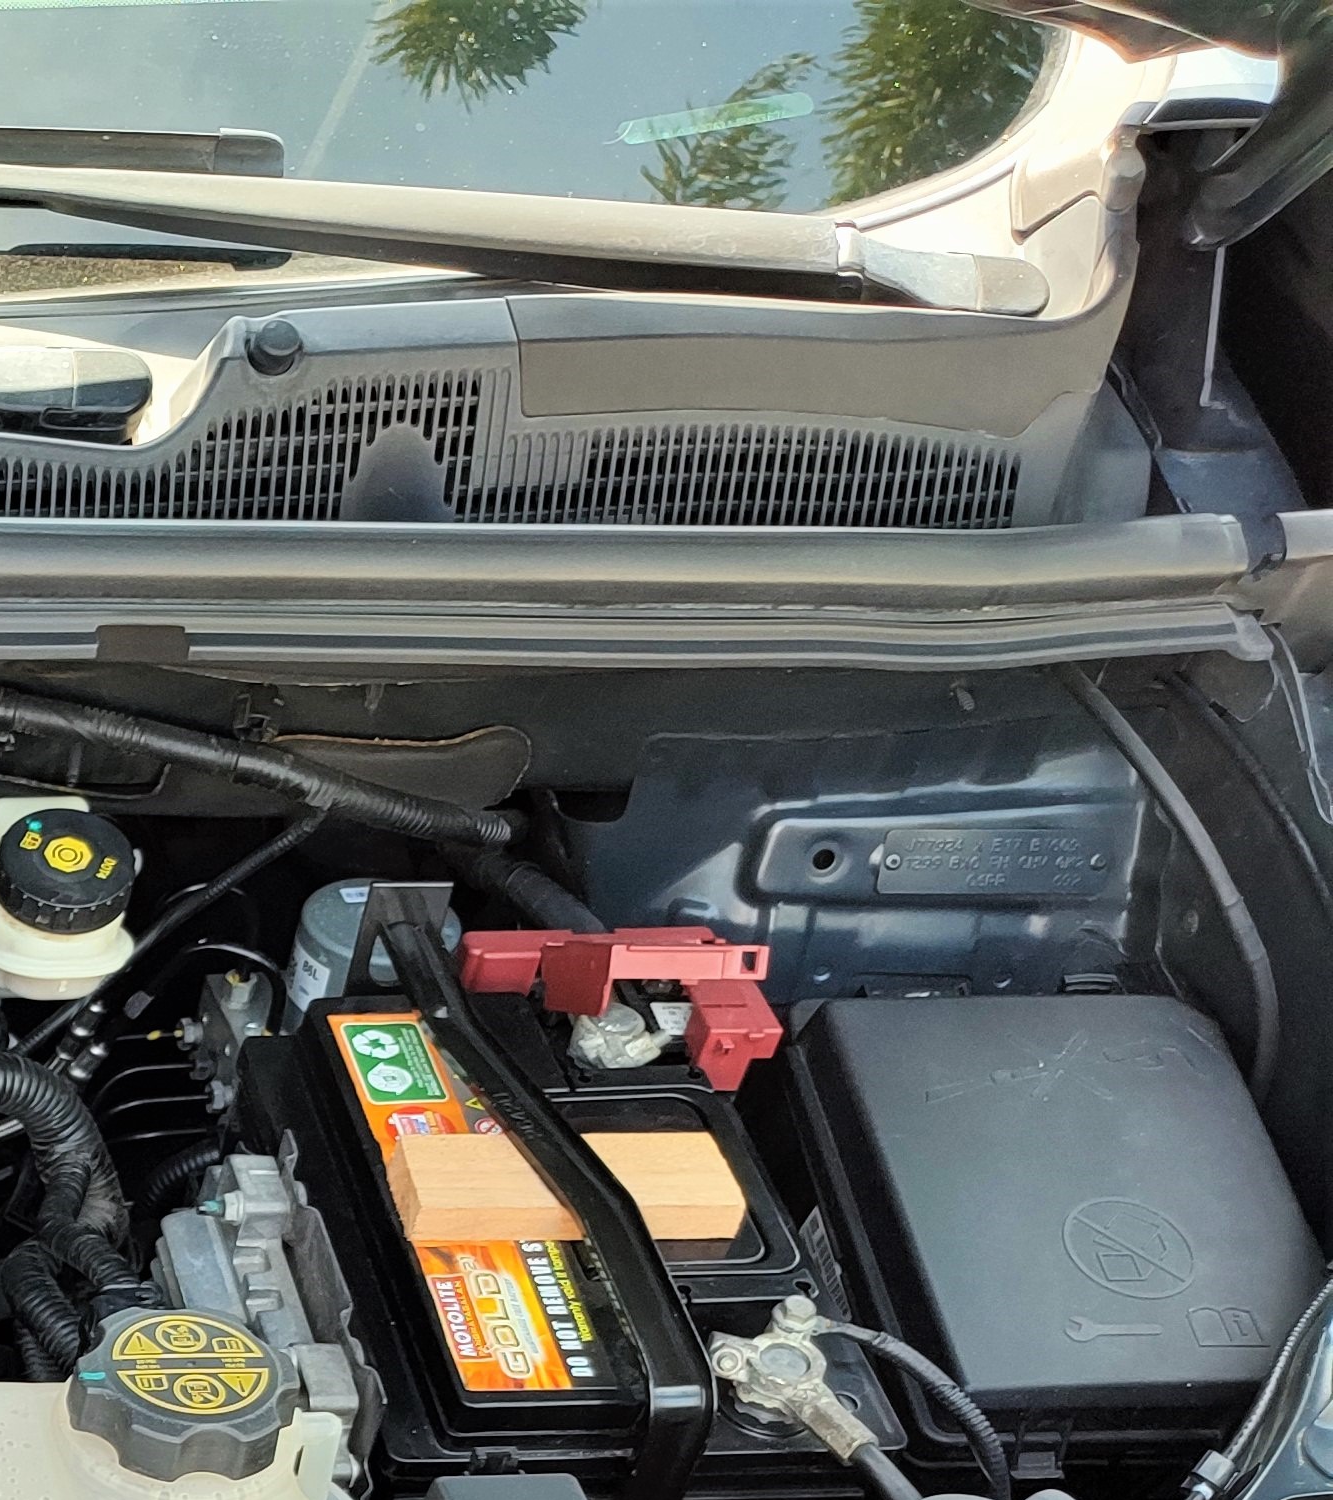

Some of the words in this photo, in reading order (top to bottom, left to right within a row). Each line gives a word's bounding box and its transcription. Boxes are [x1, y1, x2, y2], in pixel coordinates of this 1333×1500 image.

[526, 1256, 569, 1315] REMOVE
[558, 1279, 576, 1300] void
[435, 1280, 478, 1357] MOTOLITE
[476, 1272, 531, 1374] GOLD
[550, 1320, 583, 1351] NOT
[567, 1300, 593, 1343] Warranty
[565, 1355, 595, 1377] DO
